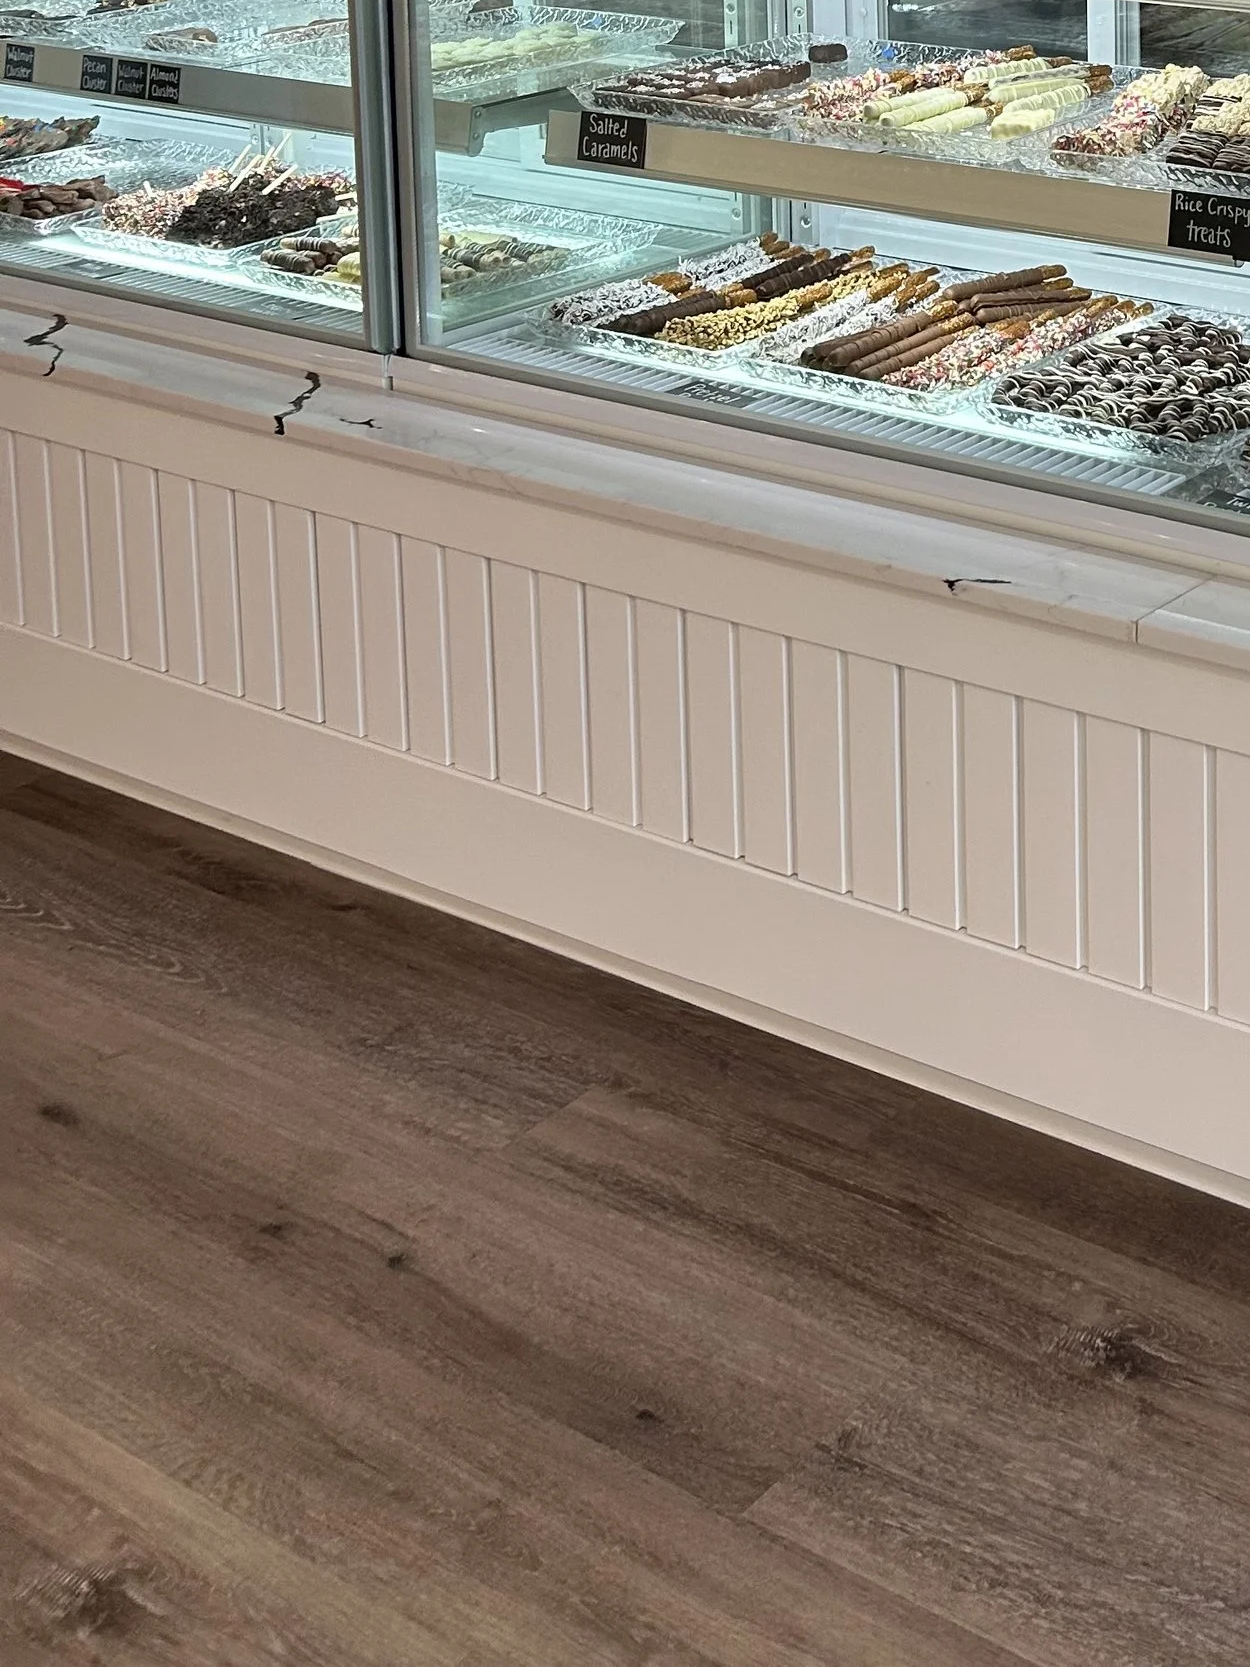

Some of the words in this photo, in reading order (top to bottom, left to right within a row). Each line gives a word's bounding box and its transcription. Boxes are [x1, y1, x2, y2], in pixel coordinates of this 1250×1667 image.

[589, 113, 628, 138] Salted
[582, 136, 639, 163] Caramels
[1175, 193, 1203, 213] Rice
[1207, 197, 1250, 228] Crispy
[1186, 219, 1231, 248] treats
